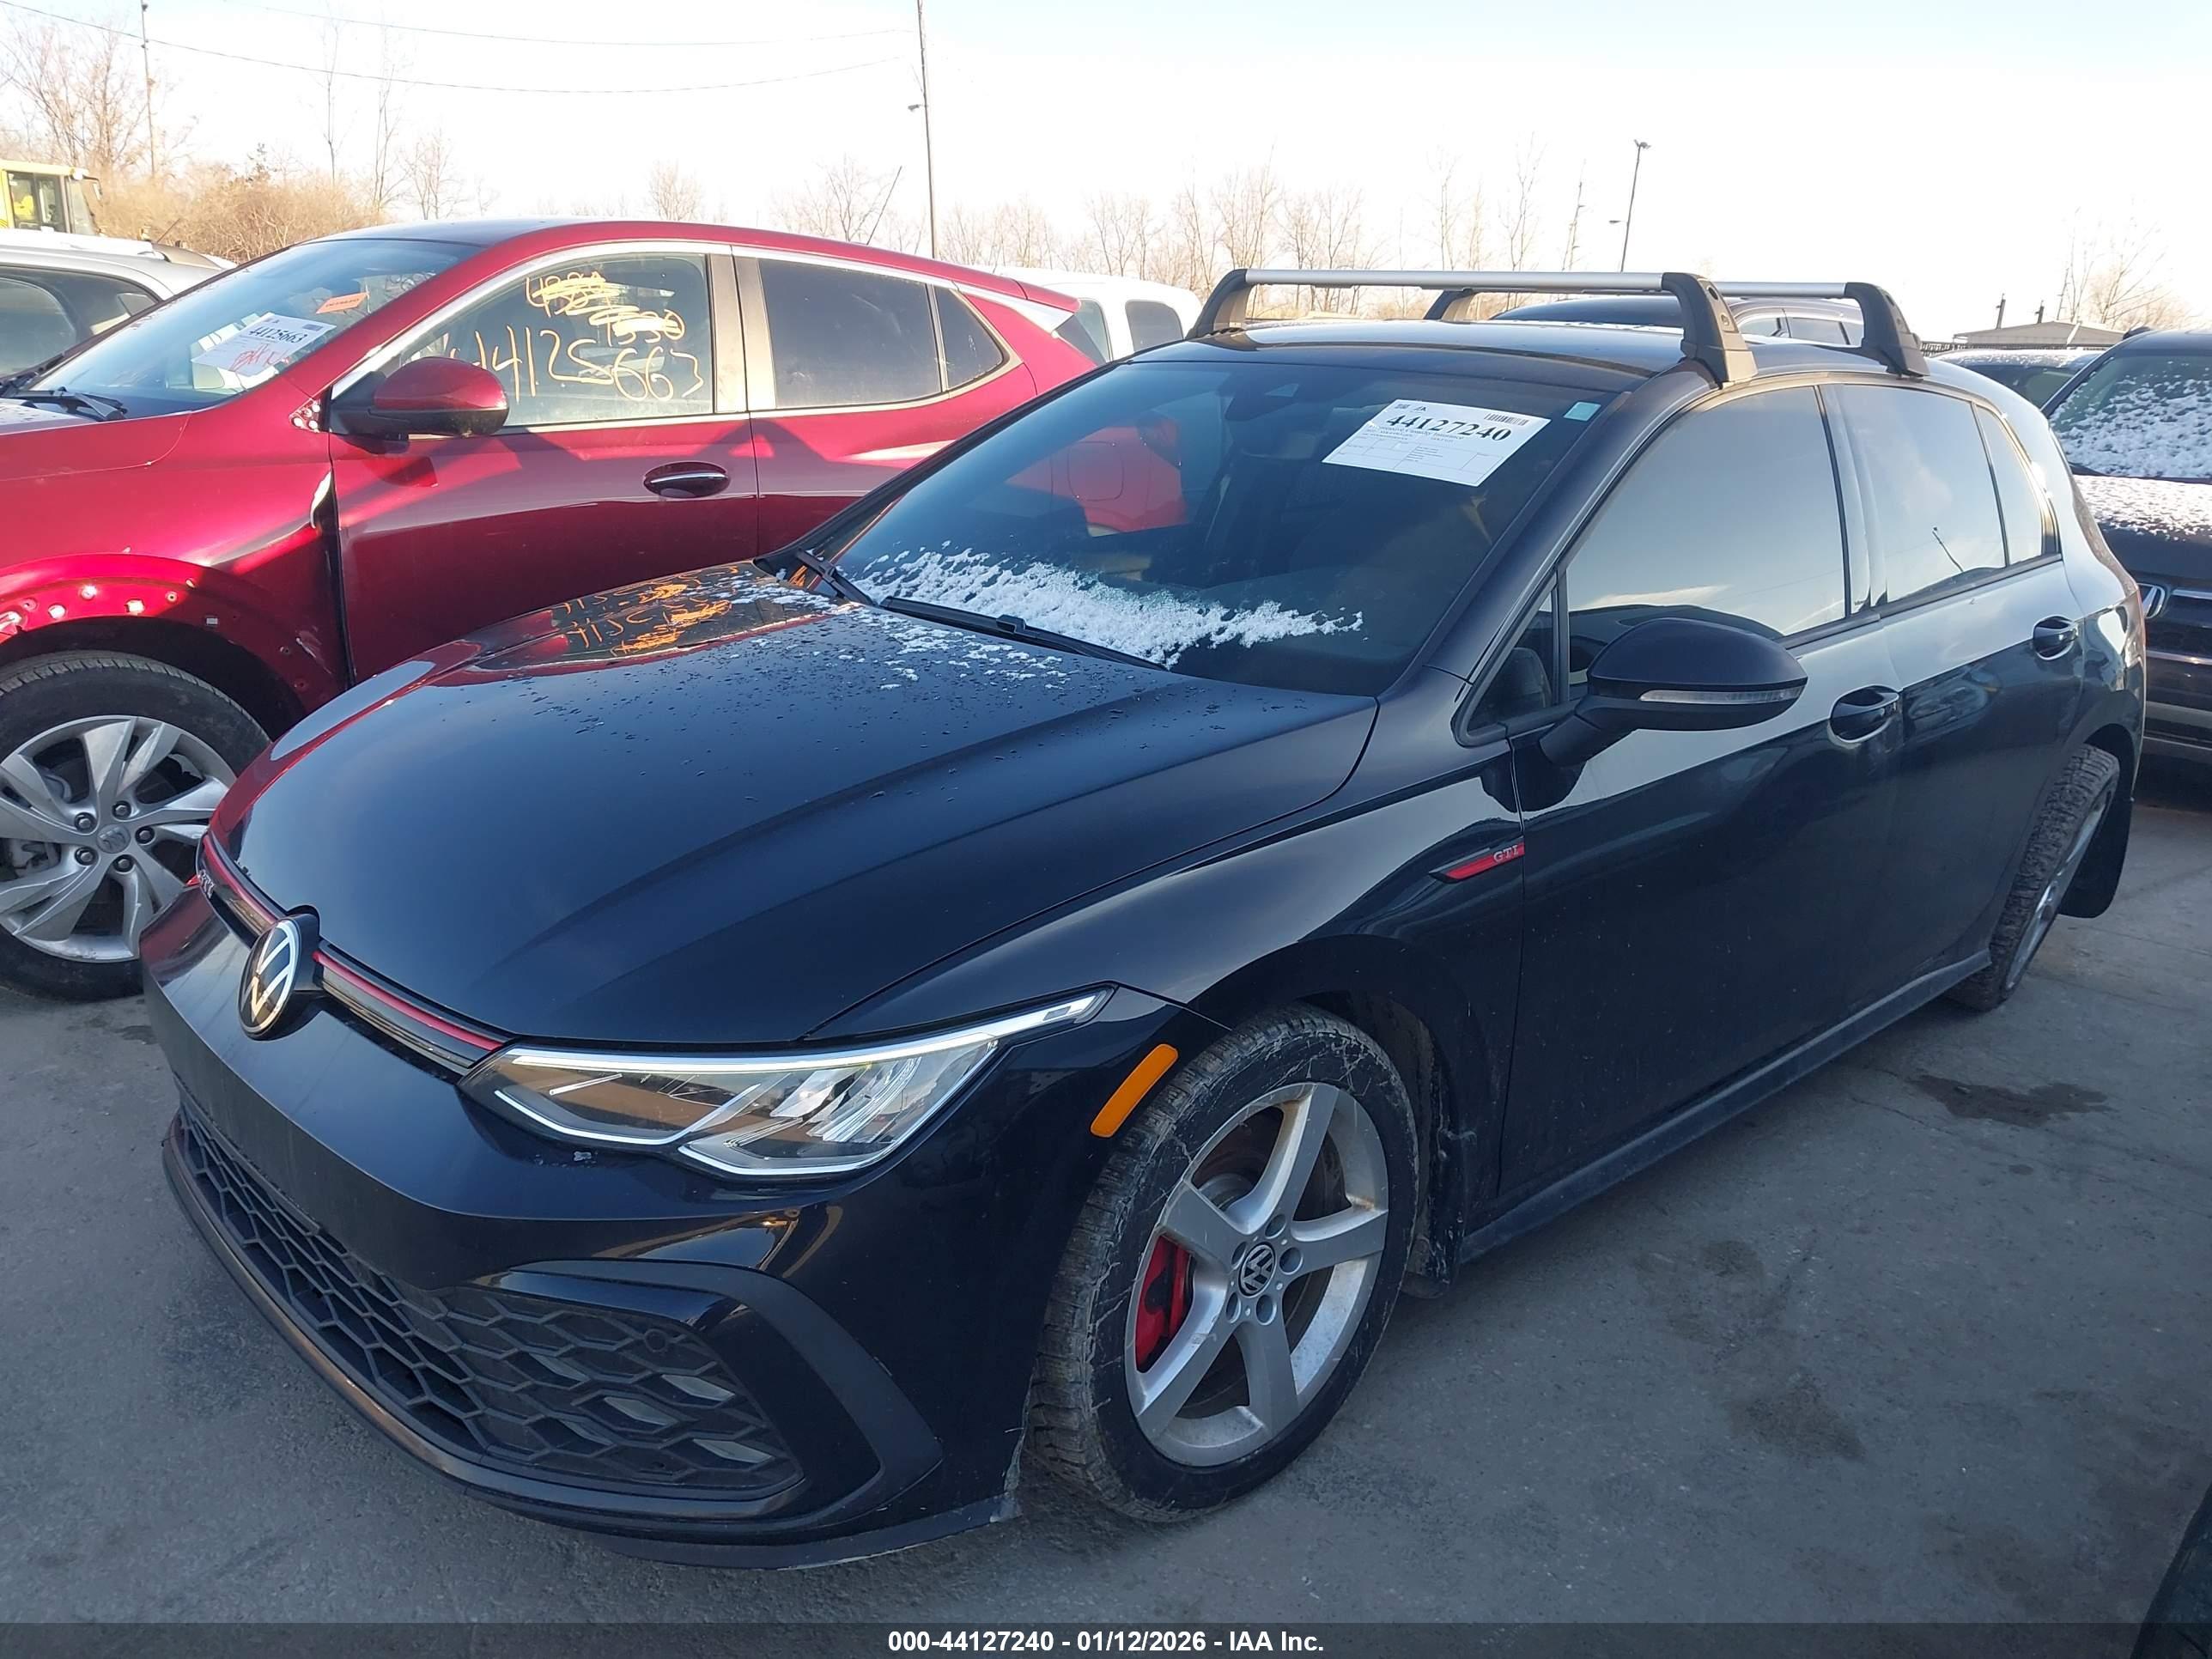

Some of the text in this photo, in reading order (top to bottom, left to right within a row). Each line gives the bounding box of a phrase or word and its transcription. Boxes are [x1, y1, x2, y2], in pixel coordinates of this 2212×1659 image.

[248, 326, 308, 343] 44125663
[1386, 415, 1512, 441] 44127240
[1494, 844, 1519, 864] GTI
